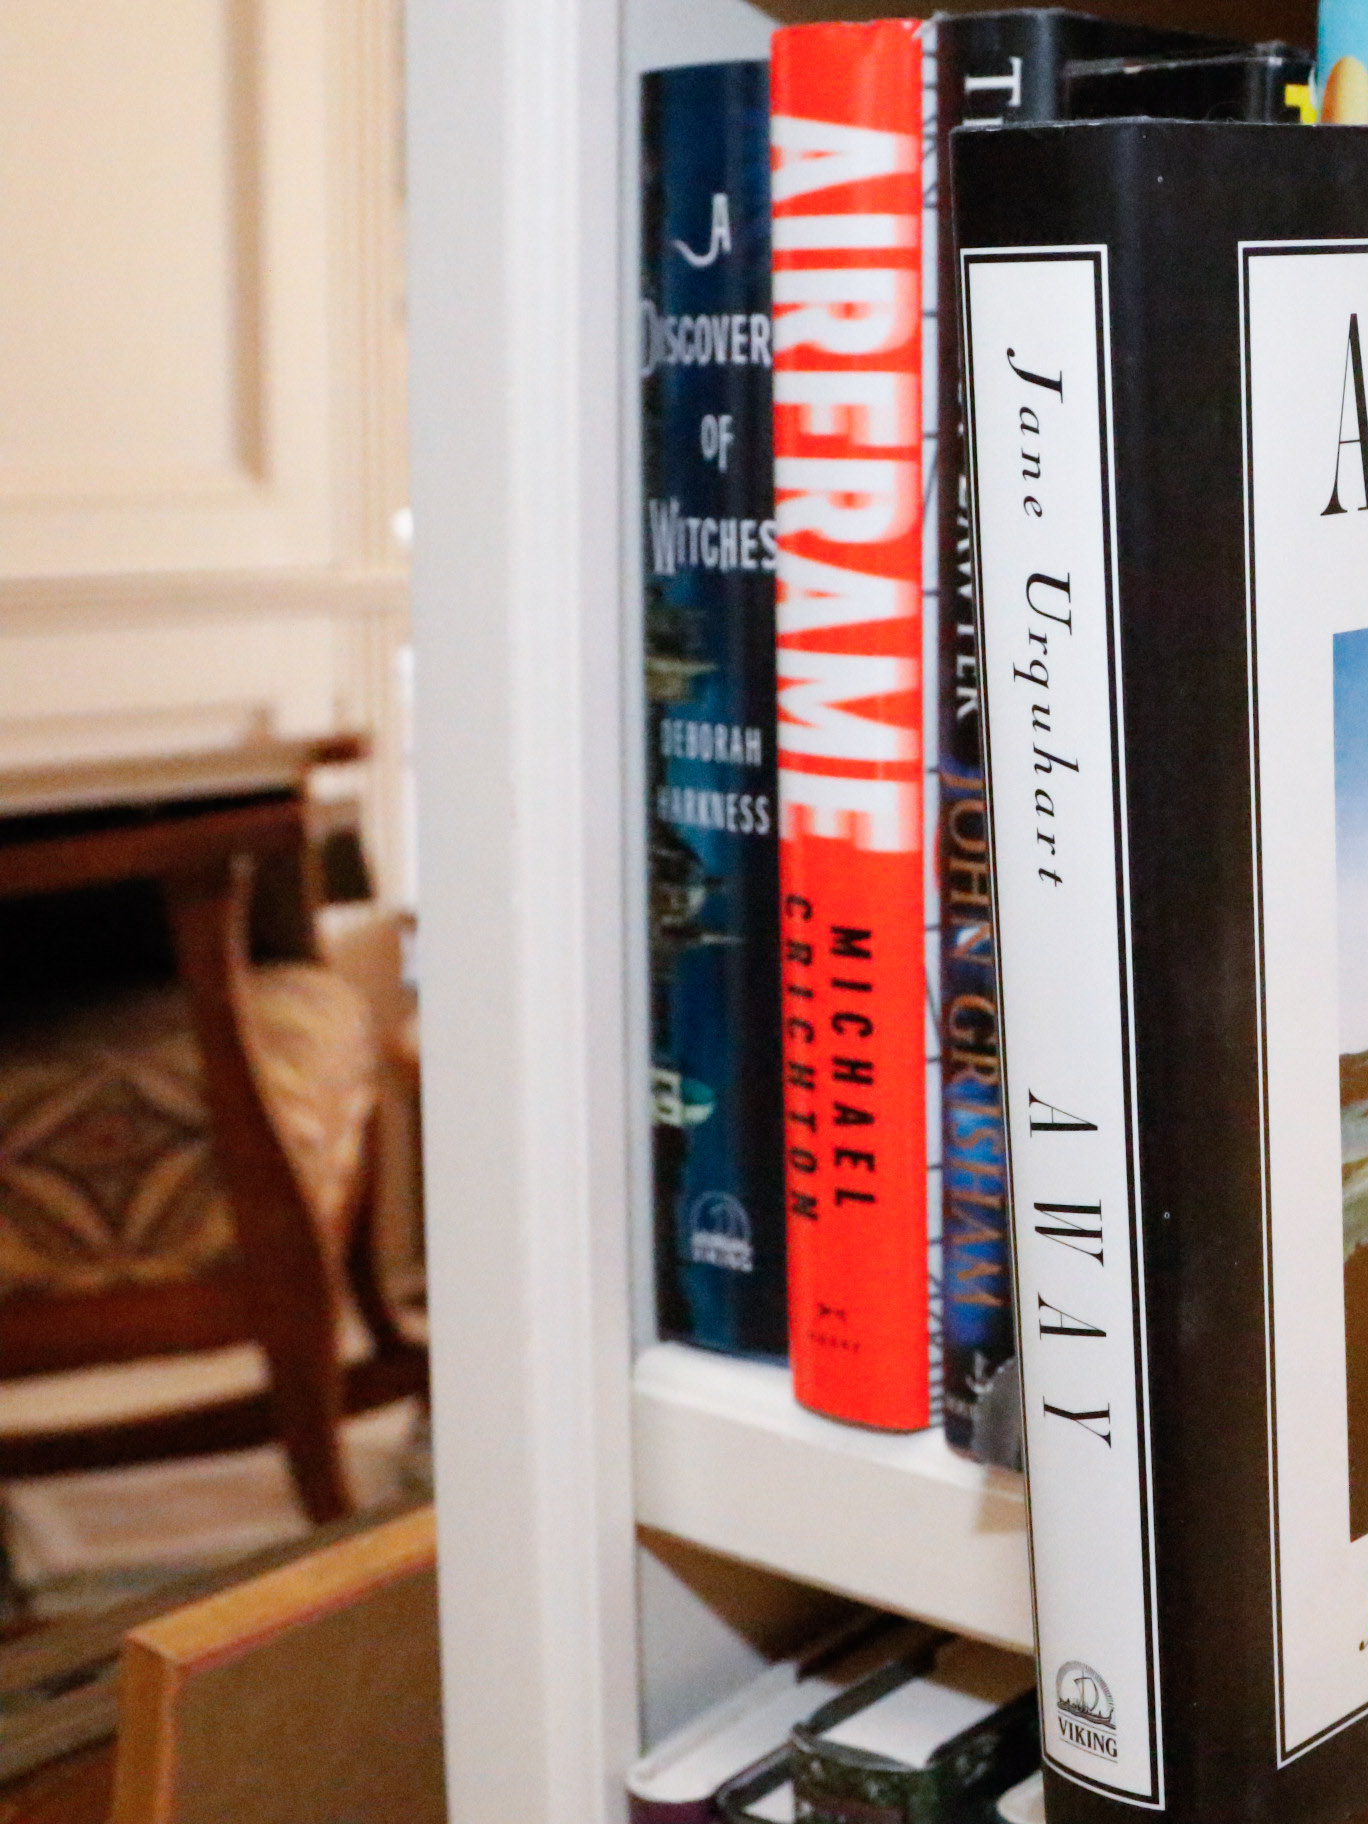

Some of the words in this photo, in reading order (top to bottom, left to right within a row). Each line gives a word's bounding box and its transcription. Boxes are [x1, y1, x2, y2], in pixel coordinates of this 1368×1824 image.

[672, 193, 732, 268] A
[640, 298, 773, 379] DISCOVER
[700, 413, 735, 472] OF
[771, 114, 917, 854] AIRFRAME
[1005, 346, 1065, 519] Jane
[648, 497, 778, 575] WITCHES
[1011, 571, 1081, 888] Urquhart
[785, 894, 820, 1222] CRICHTON
[829, 923, 877, 1209] MICHAEL
[1028, 1087, 1112, 1449] AWAY
[1057, 1715, 1118, 1758] VIKING
